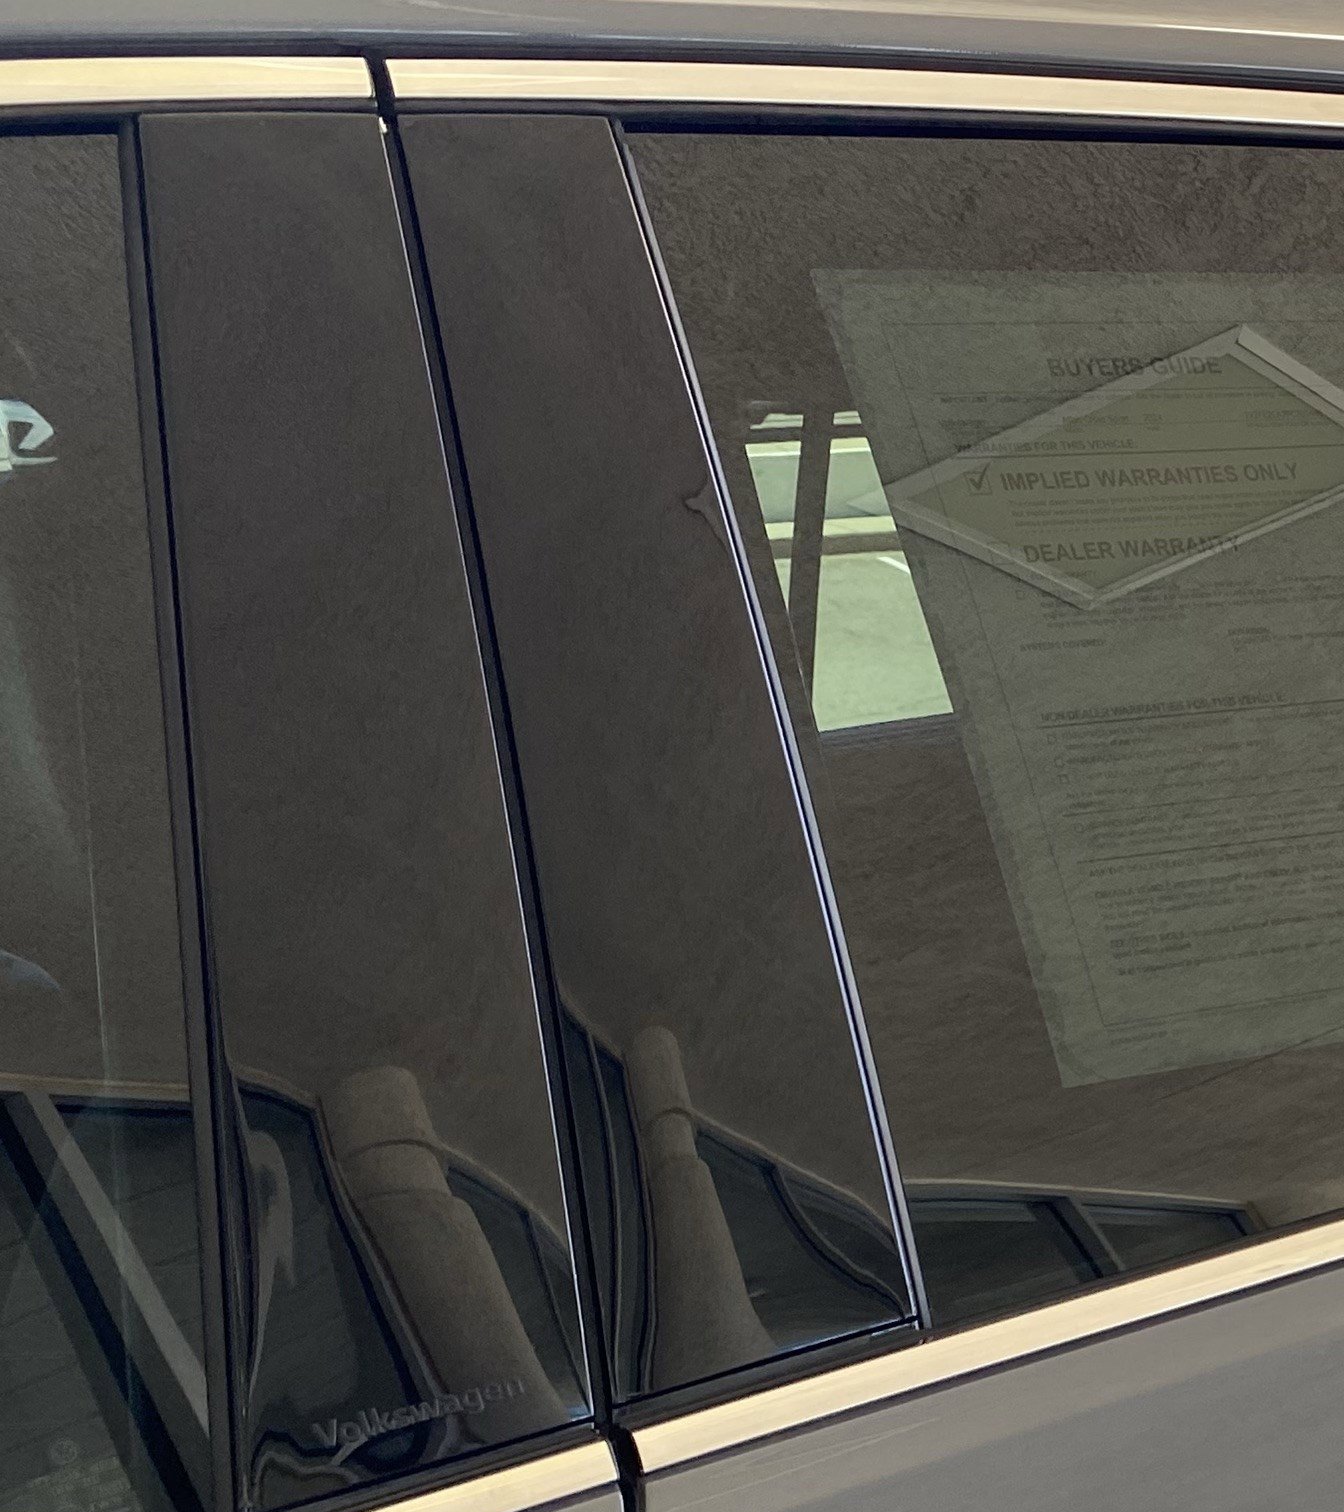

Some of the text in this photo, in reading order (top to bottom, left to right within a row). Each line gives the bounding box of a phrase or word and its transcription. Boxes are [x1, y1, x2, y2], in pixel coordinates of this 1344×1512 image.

[1047, 356, 1223, 378] BUYERS GUIDE
[1000, 462, 1298, 492] IMPLIED WARRANTIES ONLY
[1023, 534, 1239, 564] DEALER WARRANTY
[311, 1378, 525, 1447] Volkswagen
